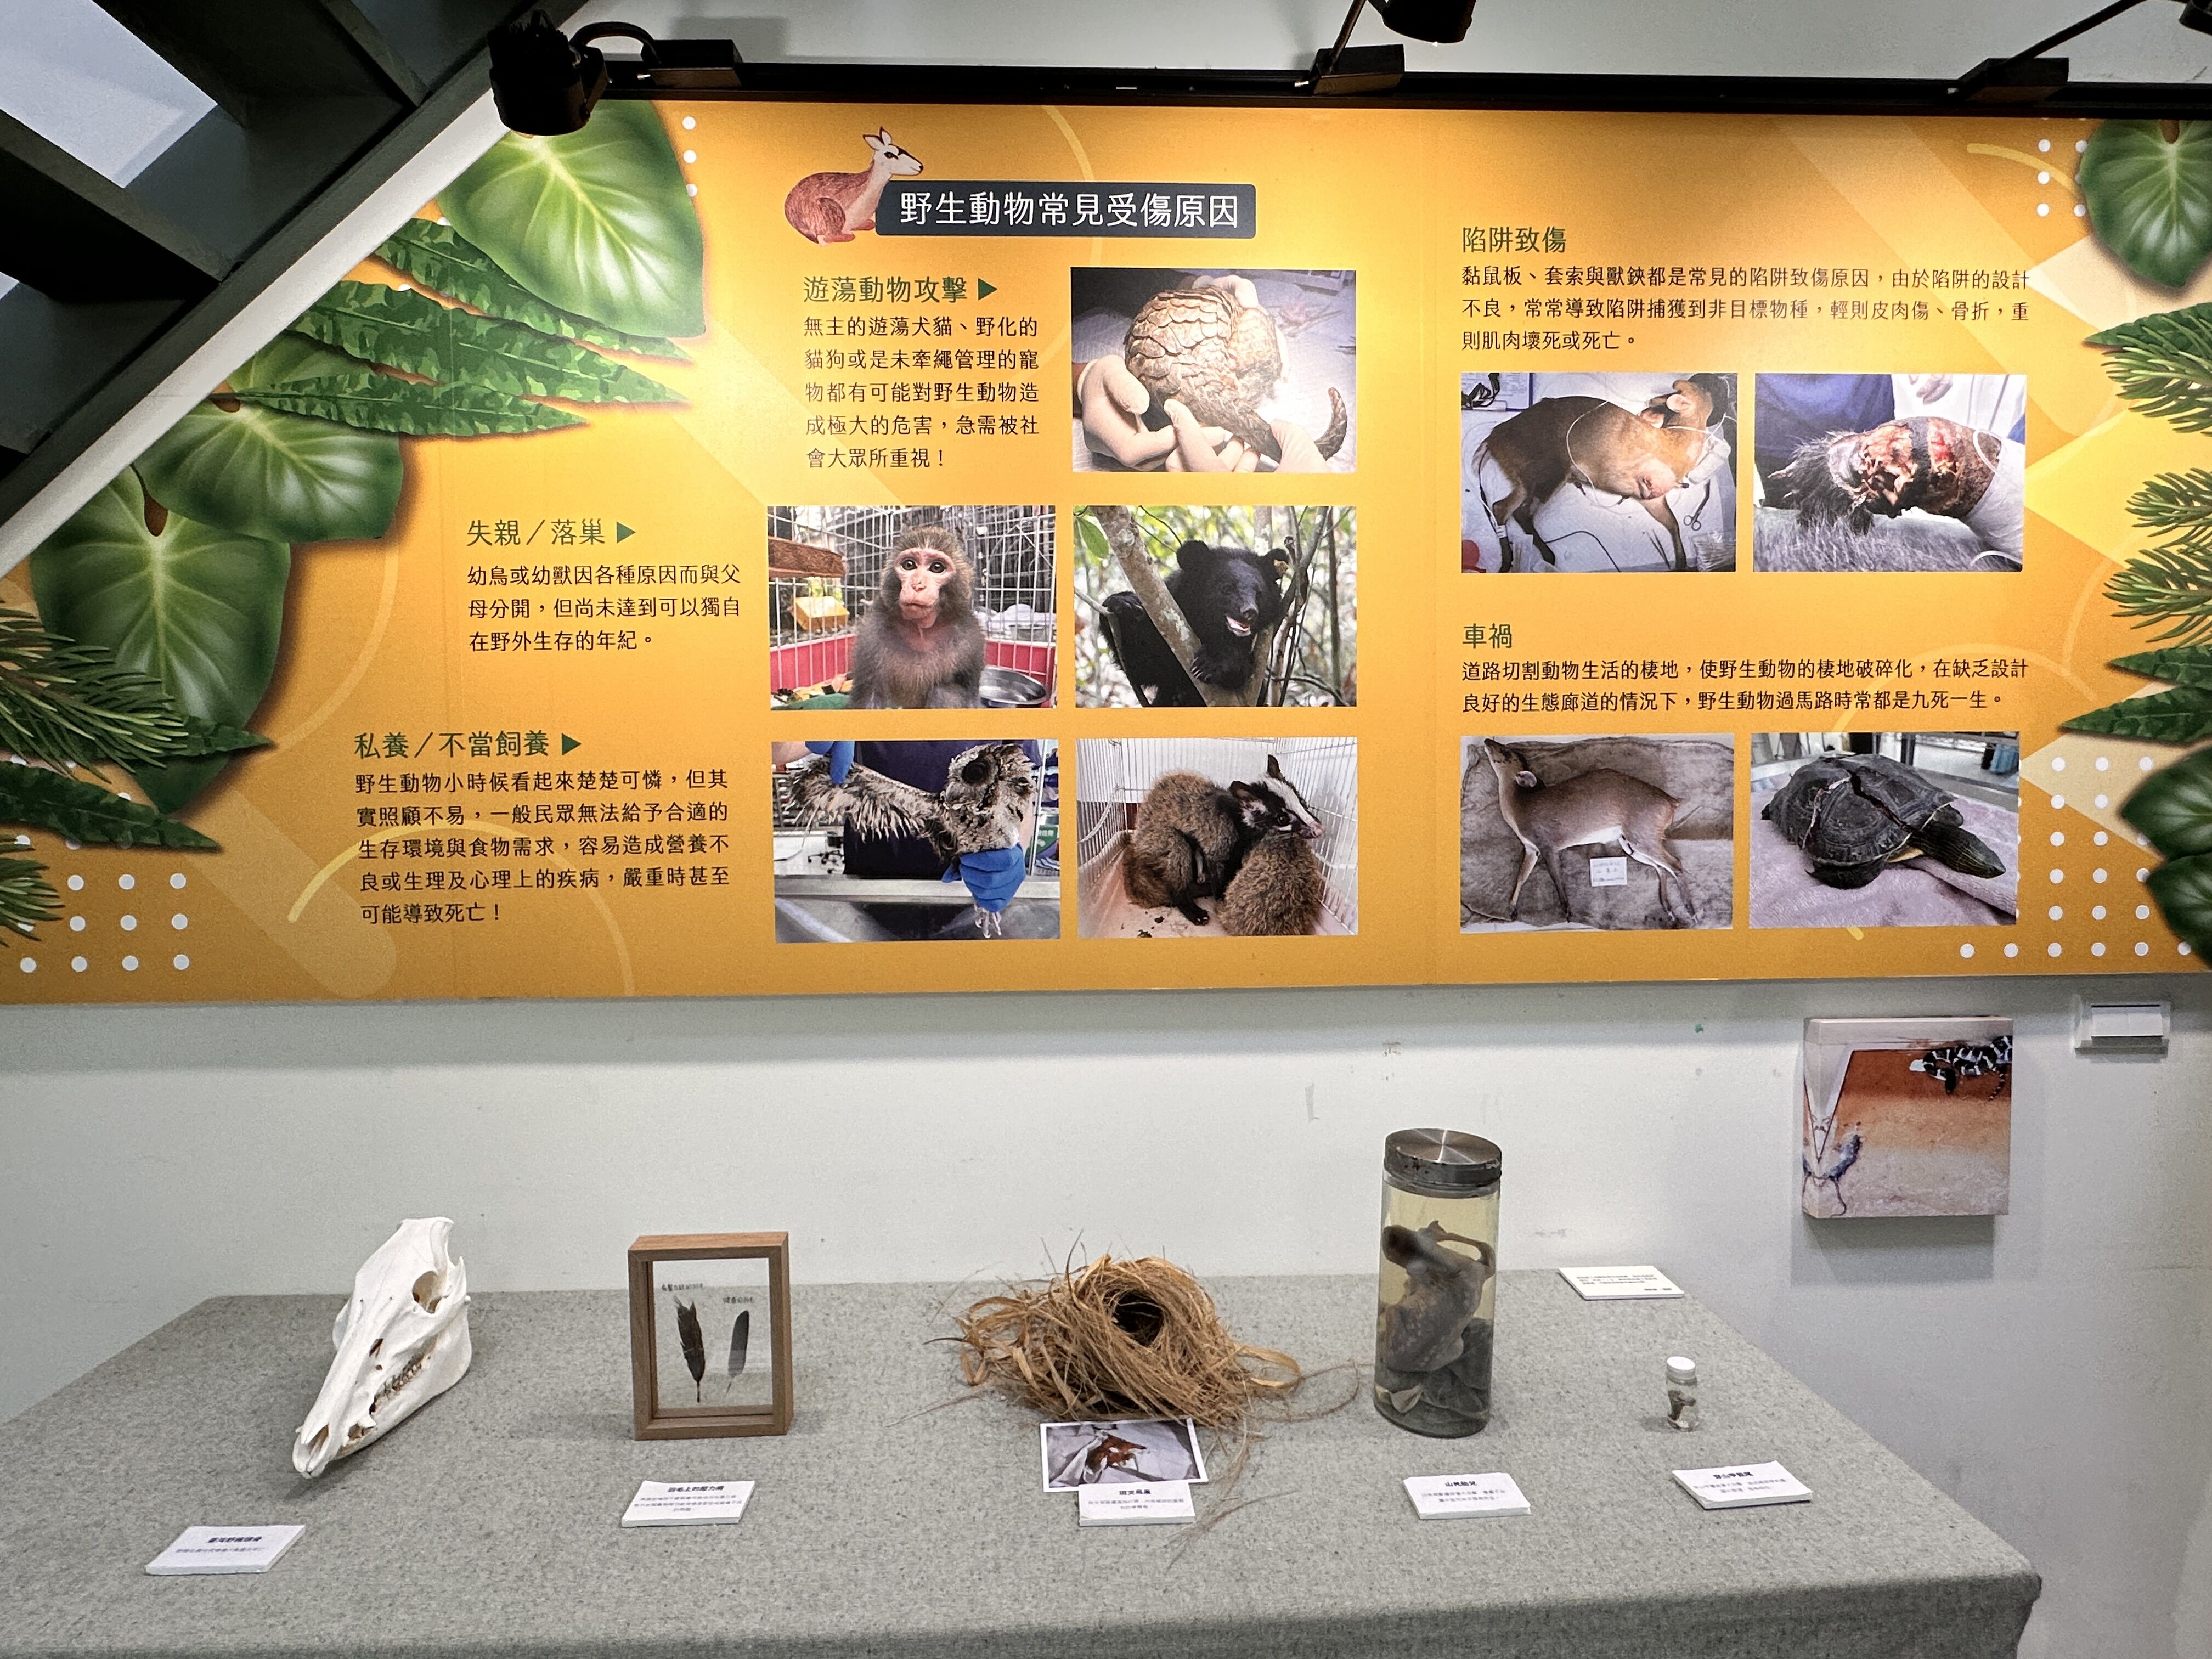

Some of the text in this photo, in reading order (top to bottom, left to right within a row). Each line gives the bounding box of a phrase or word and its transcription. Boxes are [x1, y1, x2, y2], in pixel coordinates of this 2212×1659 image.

[900, 191, 1238, 228] 野生動物常見受傷原因
[1463, 226, 1567, 253] 陷阱致傷
[803, 275, 968, 303] 遊蕩動物攻擊
[1462, 265, 2030, 290] 黏鼠板、套索與獸鋏都是常見的陷阱致傷原因，由於陷阱的設計
[1462, 297, 2029, 321] 不良，常常導致陷阱捕獲到非目標物種，輕則皮肉傷、骨折，重
[804, 315, 1037, 337] 無主的遊蕩犬貓、野化的
[1462, 330, 1635, 351] 則肌肉壞死或死亡。
[804, 348, 1039, 370] 貓狗或是未牽繩管理的寵
[805, 381, 1039, 403] 物都有可能對野生動物造
[805, 414, 1040, 436] 成極大的危害，急需被社
[806, 448, 943, 469] 會大眾所重視！
[466, 518, 606, 546] 失親／落巢
[467, 563, 741, 586] 幼鳥或幼獸因各種原因而與父
[467, 596, 739, 619] 母分開，但尚未達到可以獨自
[469, 630, 652, 652] 在野外生存的年紀。
[1462, 623, 1513, 650] 車禍
[1462, 658, 2029, 681] 道路切割動物生活的棲地，使野生動物的棲地破碎化，在缺乏設計
[1462, 690, 2001, 713] 良好的生態廊道的情況下，野生動物過馬路時常都是九死一生。
[354, 730, 549, 759] 私養／不當飼養
[356, 768, 728, 794] 野生動物小時候看起來楚楚可憐，但其
[357, 800, 727, 827] 實照顧不易，一般民眾無法給予合適的
[358, 833, 729, 860] 生存環境與食物需求，容易造成營養不
[360, 866, 730, 892] 良或生理及心理上的疾病，嚴重時甚至
[360, 901, 499, 925] 可能導致死亡！
